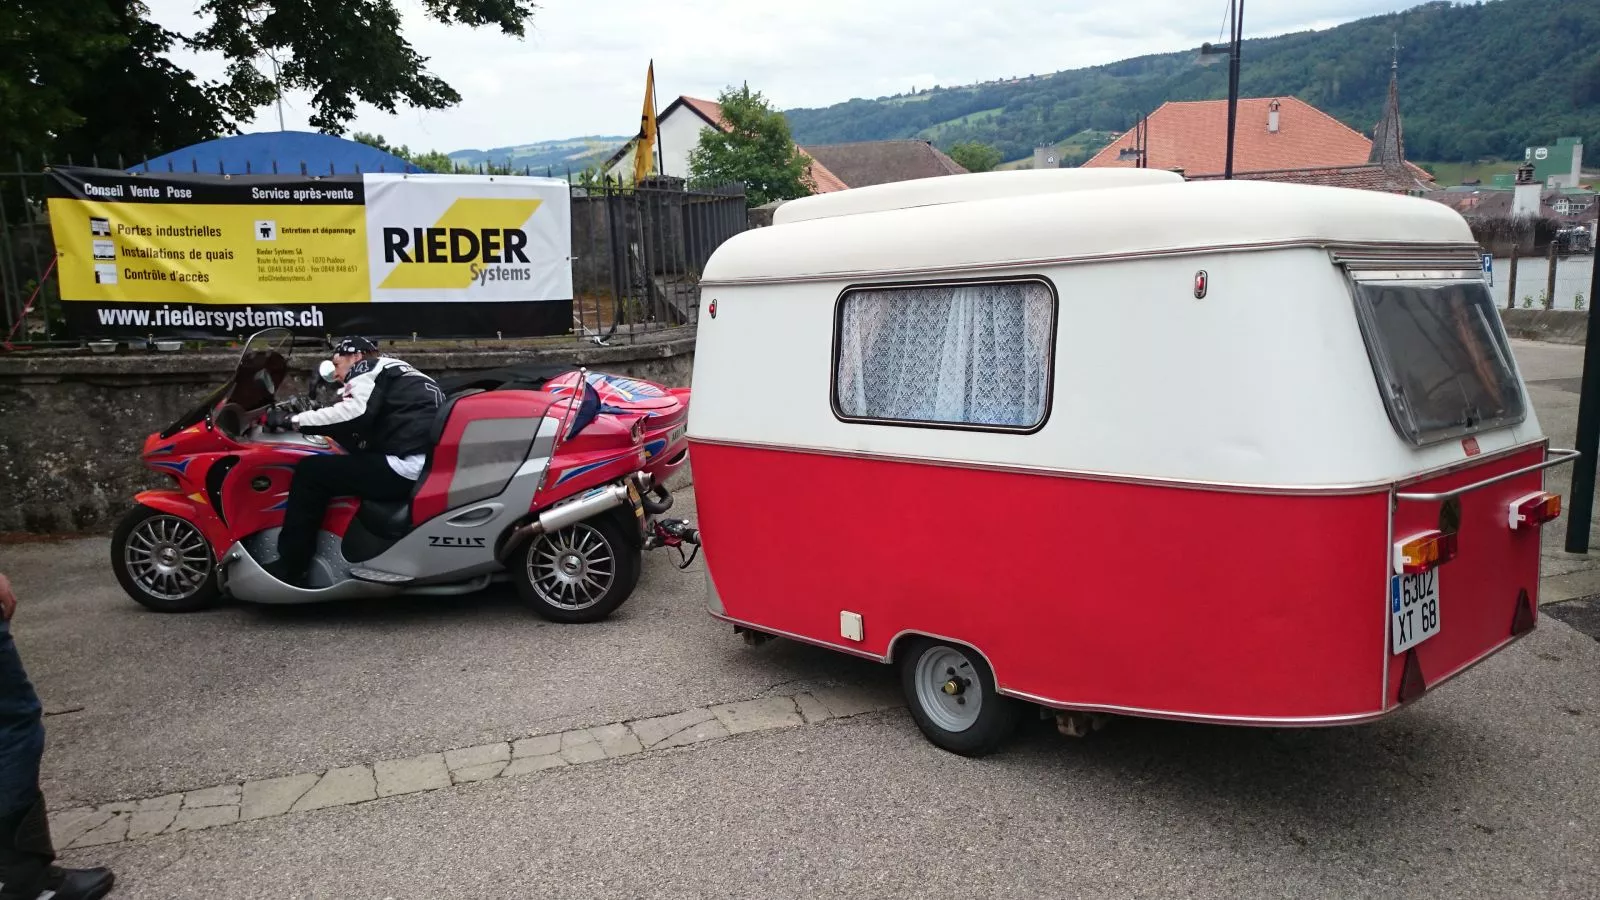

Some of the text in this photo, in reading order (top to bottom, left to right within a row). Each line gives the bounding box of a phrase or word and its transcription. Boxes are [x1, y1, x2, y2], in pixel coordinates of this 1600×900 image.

[84, 183, 192, 199] Conseil Vente Pose
[252, 187, 354, 201] Service après-vente
[117, 223, 222, 237] Portes industrielles
[320, 226, 356, 235] dépannage
[383, 227, 531, 263] RIEDER
[121, 246, 234, 263] Installations de quais
[1485, 256, 1490, 272] P
[124, 268, 210, 283] Contrôle d'accès
[469, 263, 531, 286] Systems
[97, 304, 324, 330] www.riedersystems.ch
[1403, 571, 1434, 607] 6302
[1398, 599, 1437, 646] XT 68
